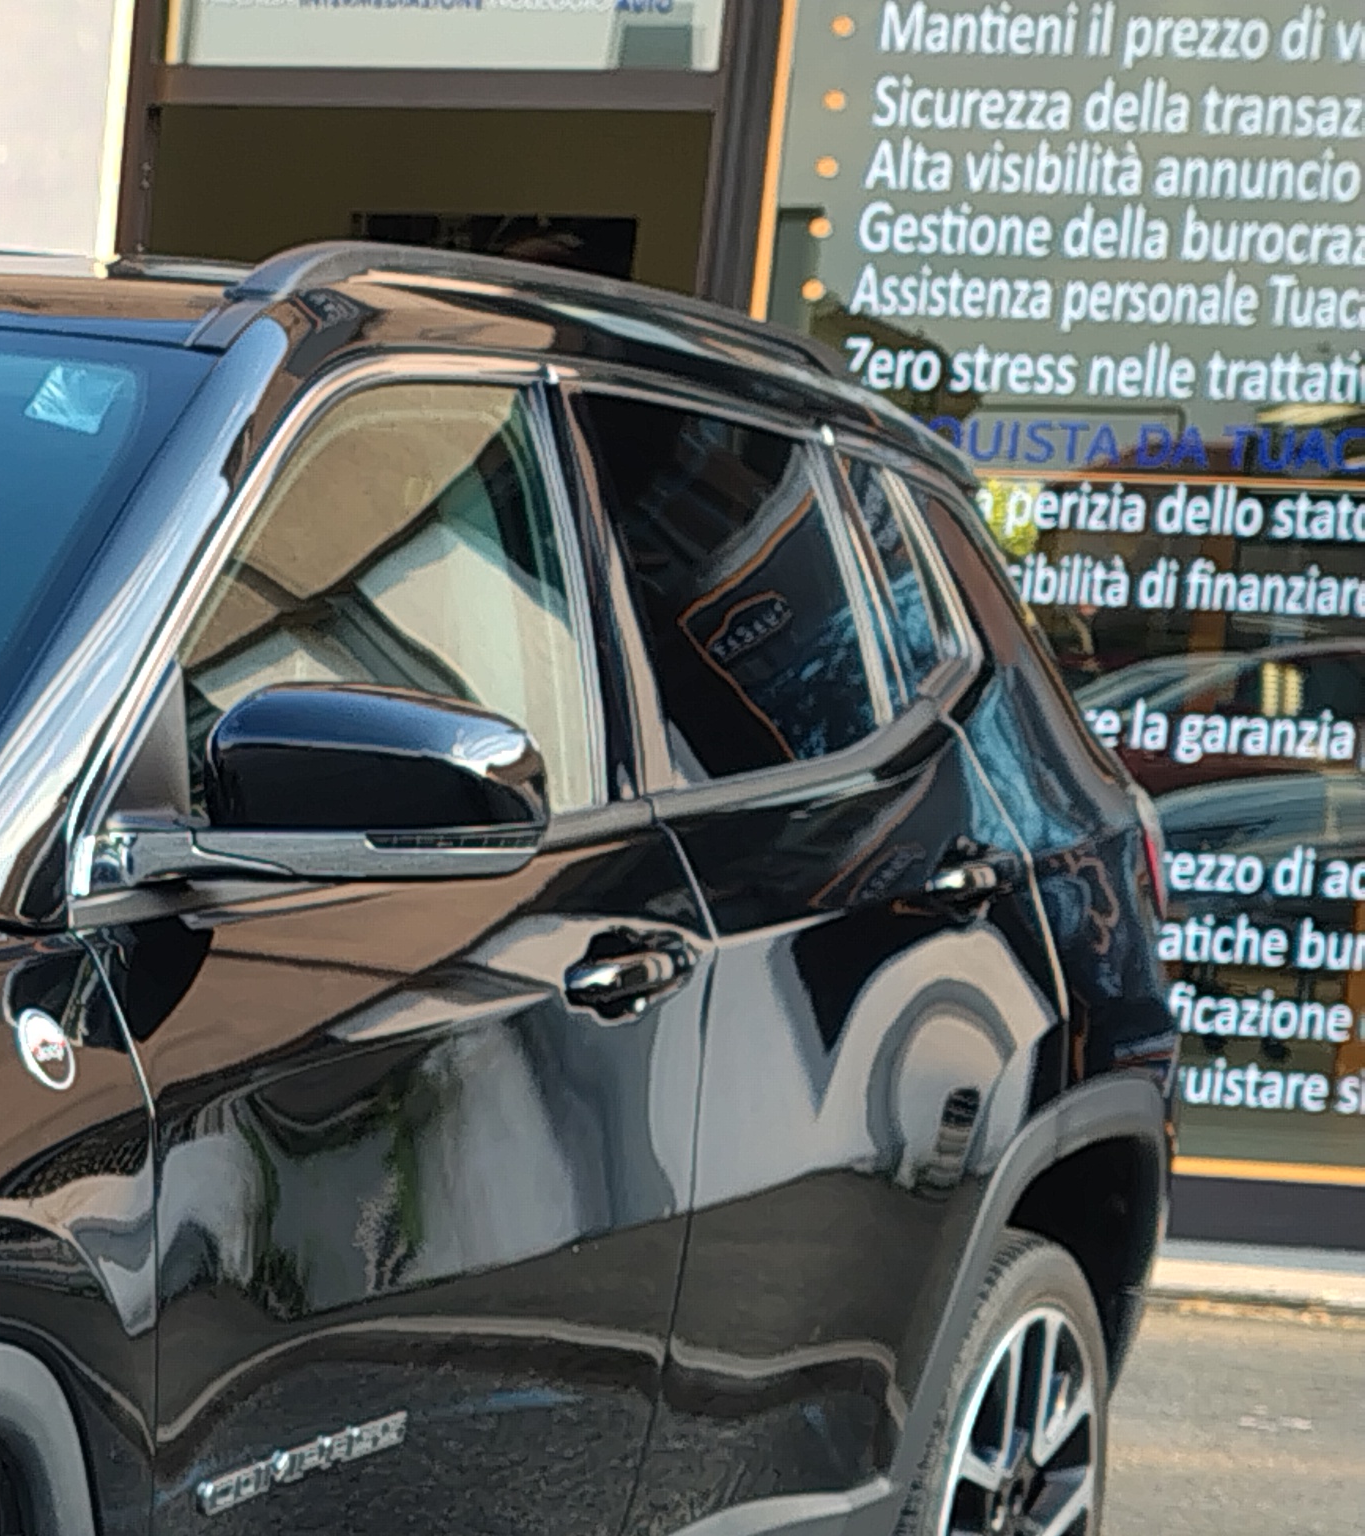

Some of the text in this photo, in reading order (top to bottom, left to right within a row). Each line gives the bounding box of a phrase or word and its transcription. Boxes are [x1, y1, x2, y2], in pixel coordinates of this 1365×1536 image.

[880, 1, 1079, 55] Mantieni
[1087, 1, 1116, 58] il
[1123, 15, 1270, 69] prezzo
[1281, 4, 1327, 60] di
[871, 73, 1072, 130] Sicurezza
[1083, 76, 1190, 133] della
[865, 135, 1361, 201] Alta visibilità annuncio
[858, 200, 1053, 257] Gestione
[1063, 202, 1169, 260] della
[849, 263, 1052, 319] Assistenza
[1060, 267, 1259, 333] personale
[947, 343, 1079, 395] stress
[1087, 341, 1196, 399] nelle
[912, 414, 1120, 465] UISTA
[1136, 422, 1208, 468] DA
[1004, 481, 1147, 536] perizia
[1155, 482, 1264, 537] dello
[1138, 556, 1179, 609] di
[1129, 698, 1169, 750] la
[1174, 708, 1356, 763] garanzia
[1163, 849, 1264, 895] ezzo
[1273, 845, 1314, 897] di
[1178, 1057, 1329, 1112] uistare
